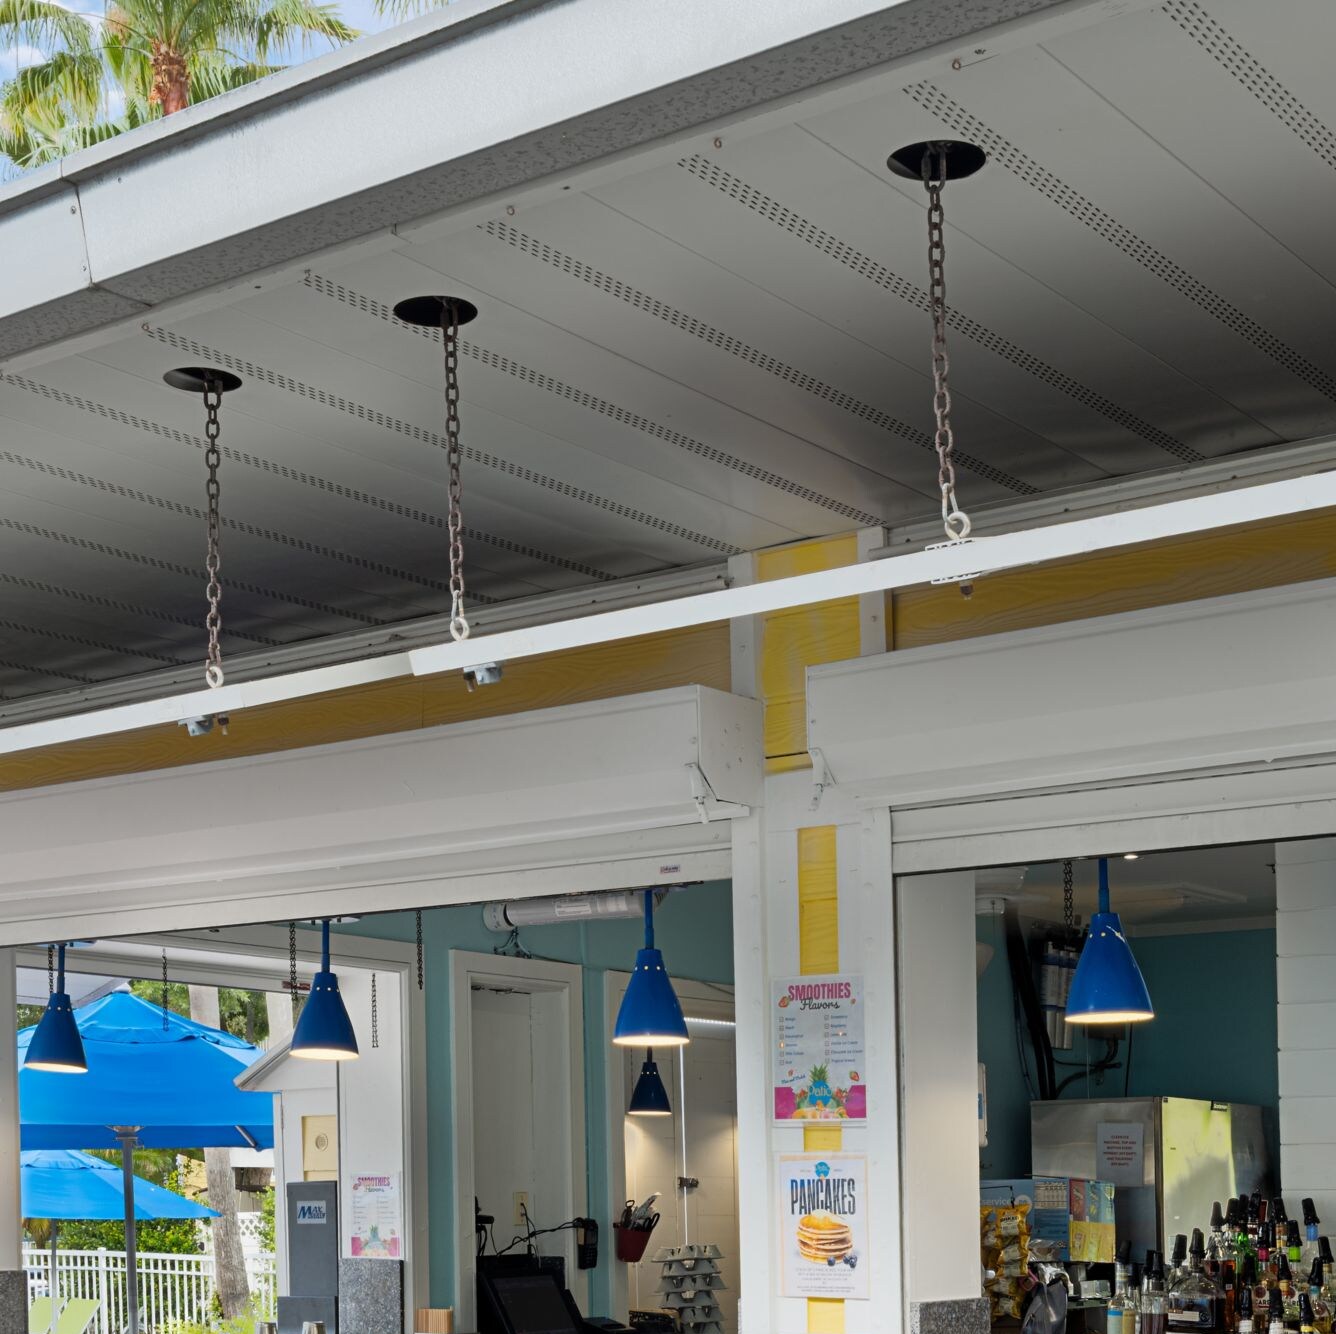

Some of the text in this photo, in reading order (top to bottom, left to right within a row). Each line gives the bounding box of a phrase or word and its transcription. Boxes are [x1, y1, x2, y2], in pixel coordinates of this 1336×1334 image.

[788, 982, 851, 1001] SMOOTHIES
[800, 997, 840, 1011] Flavors
[357, 1176, 390, 1187] SMOOTHIES
[790, 1178, 856, 1215] PANCAKES
